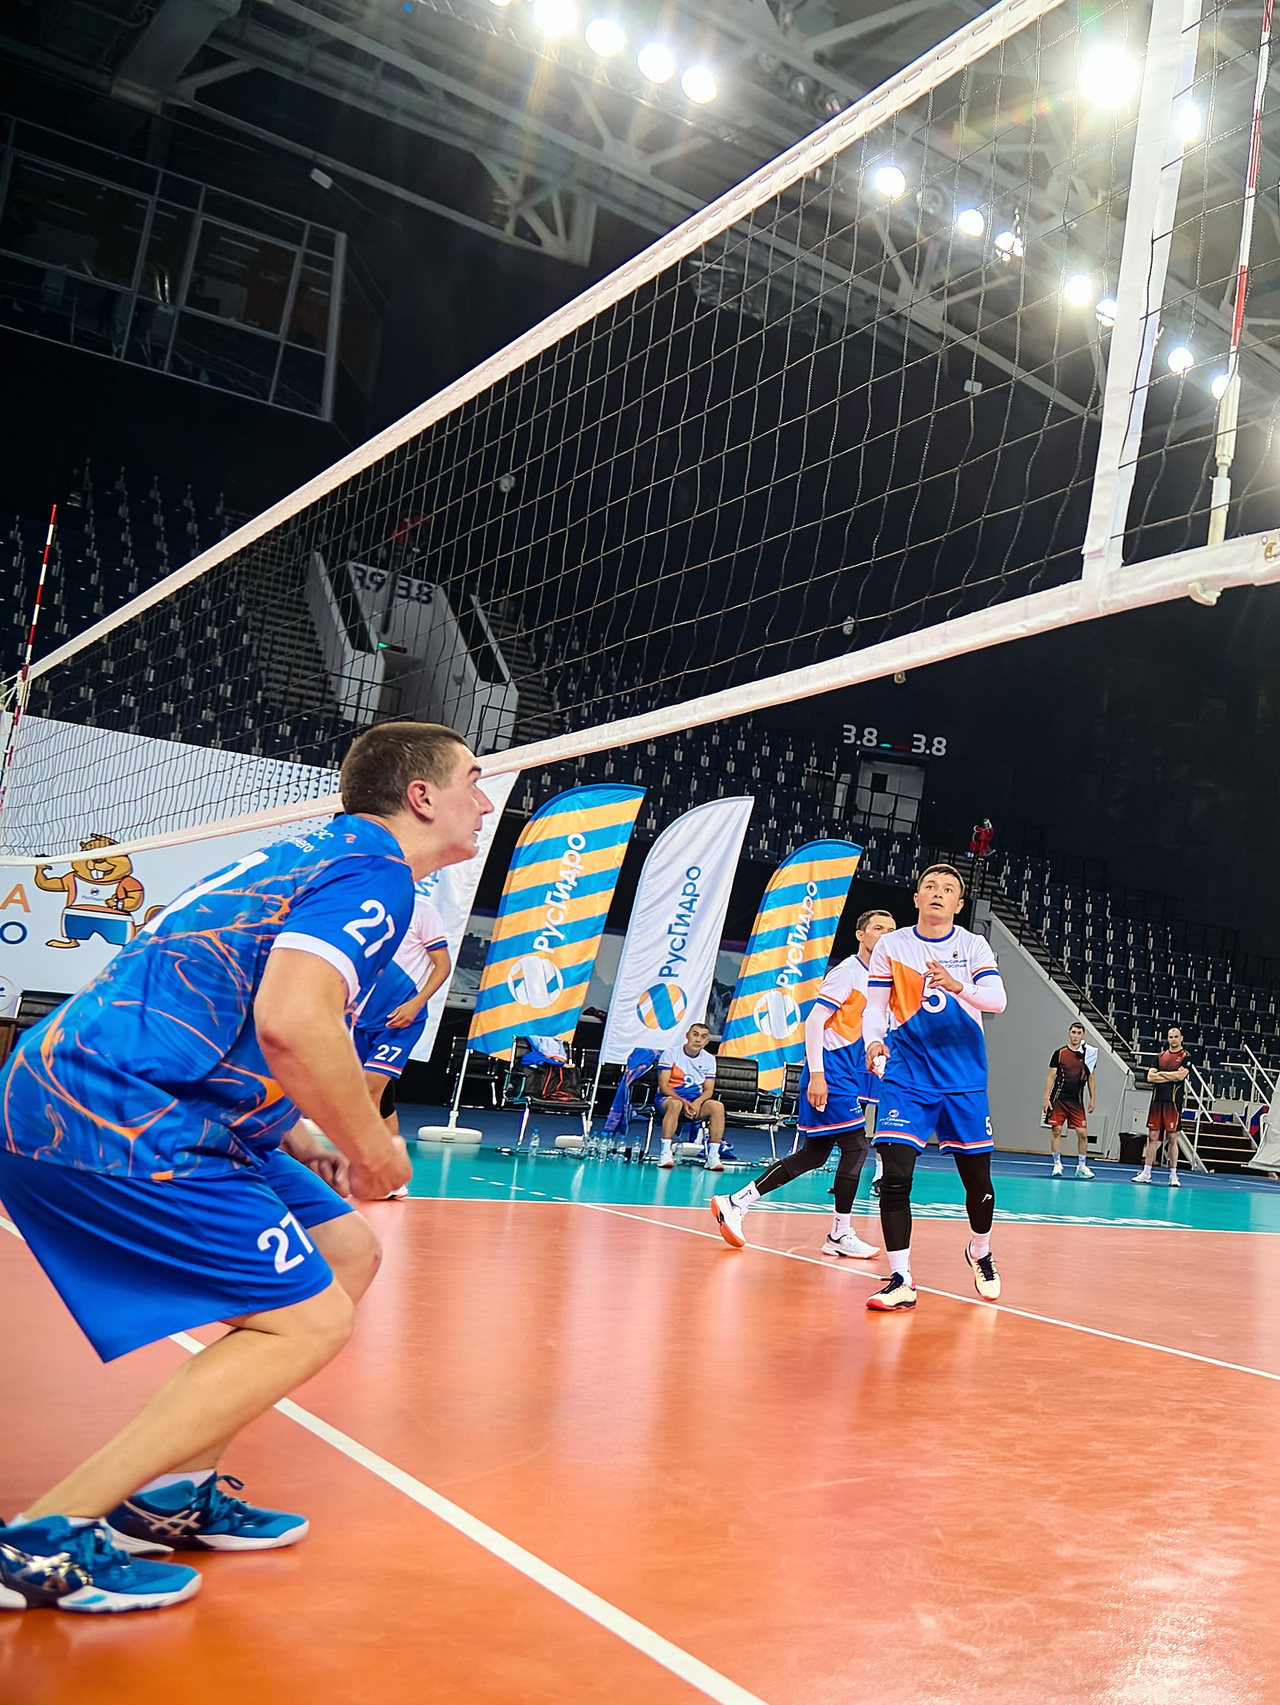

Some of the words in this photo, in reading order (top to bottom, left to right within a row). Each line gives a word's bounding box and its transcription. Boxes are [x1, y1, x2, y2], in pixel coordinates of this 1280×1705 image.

[843, 723, 878, 747] 3.8
[911, 733, 947, 756] 3.8
[342, 899, 396, 959] 27
[658, 865, 702, 979] РусГидро
[920, 973, 947, 1014] 5
[373, 1044, 403, 1063] 27
[985, 1116, 993, 1136] 5
[257, 1210, 314, 1274] 27
